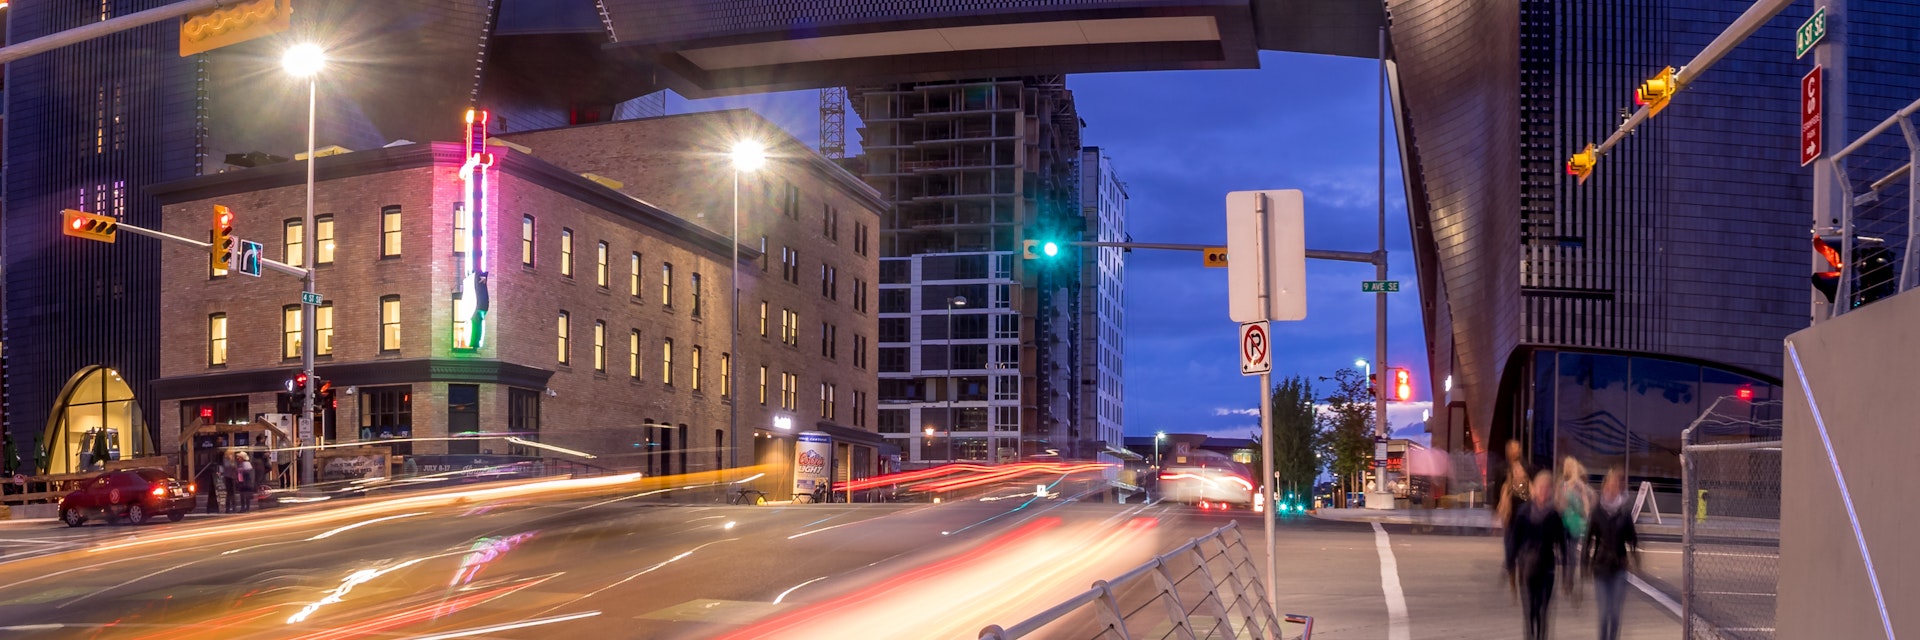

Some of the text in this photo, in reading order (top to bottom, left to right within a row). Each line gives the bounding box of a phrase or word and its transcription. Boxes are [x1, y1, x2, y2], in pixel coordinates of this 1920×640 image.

[1798, 13, 1824, 50] 4 ST SE
[303, 294, 308, 302] 4
[799, 452, 825, 466] Coors
[798, 465, 823, 474] LIGHT
